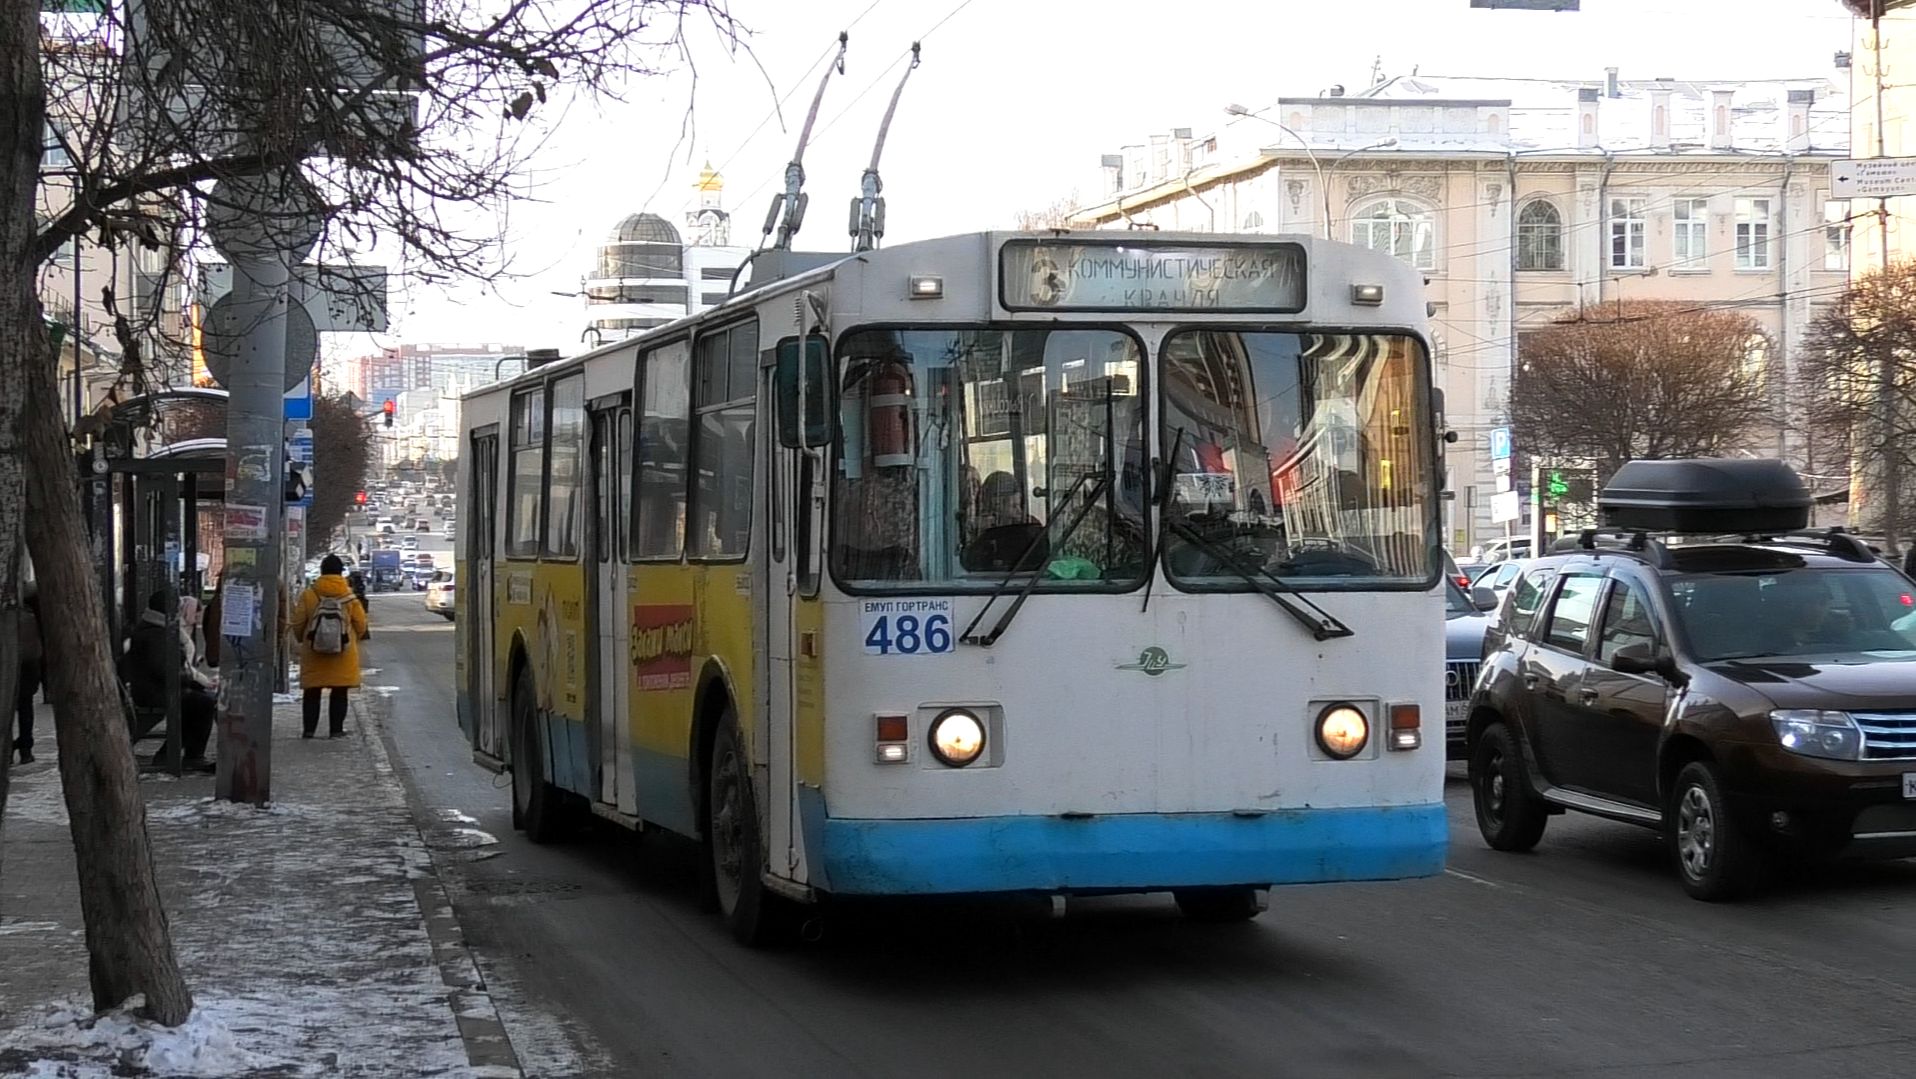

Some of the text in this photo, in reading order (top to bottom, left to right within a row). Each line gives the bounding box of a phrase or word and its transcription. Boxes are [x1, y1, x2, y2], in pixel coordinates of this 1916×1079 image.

[1068, 258, 1275, 279] КОММУНИСТИЧЕСКАЯ
[864, 601, 949, 613] ЕМУП ГОРТРАНС
[865, 614, 951, 655] 486
